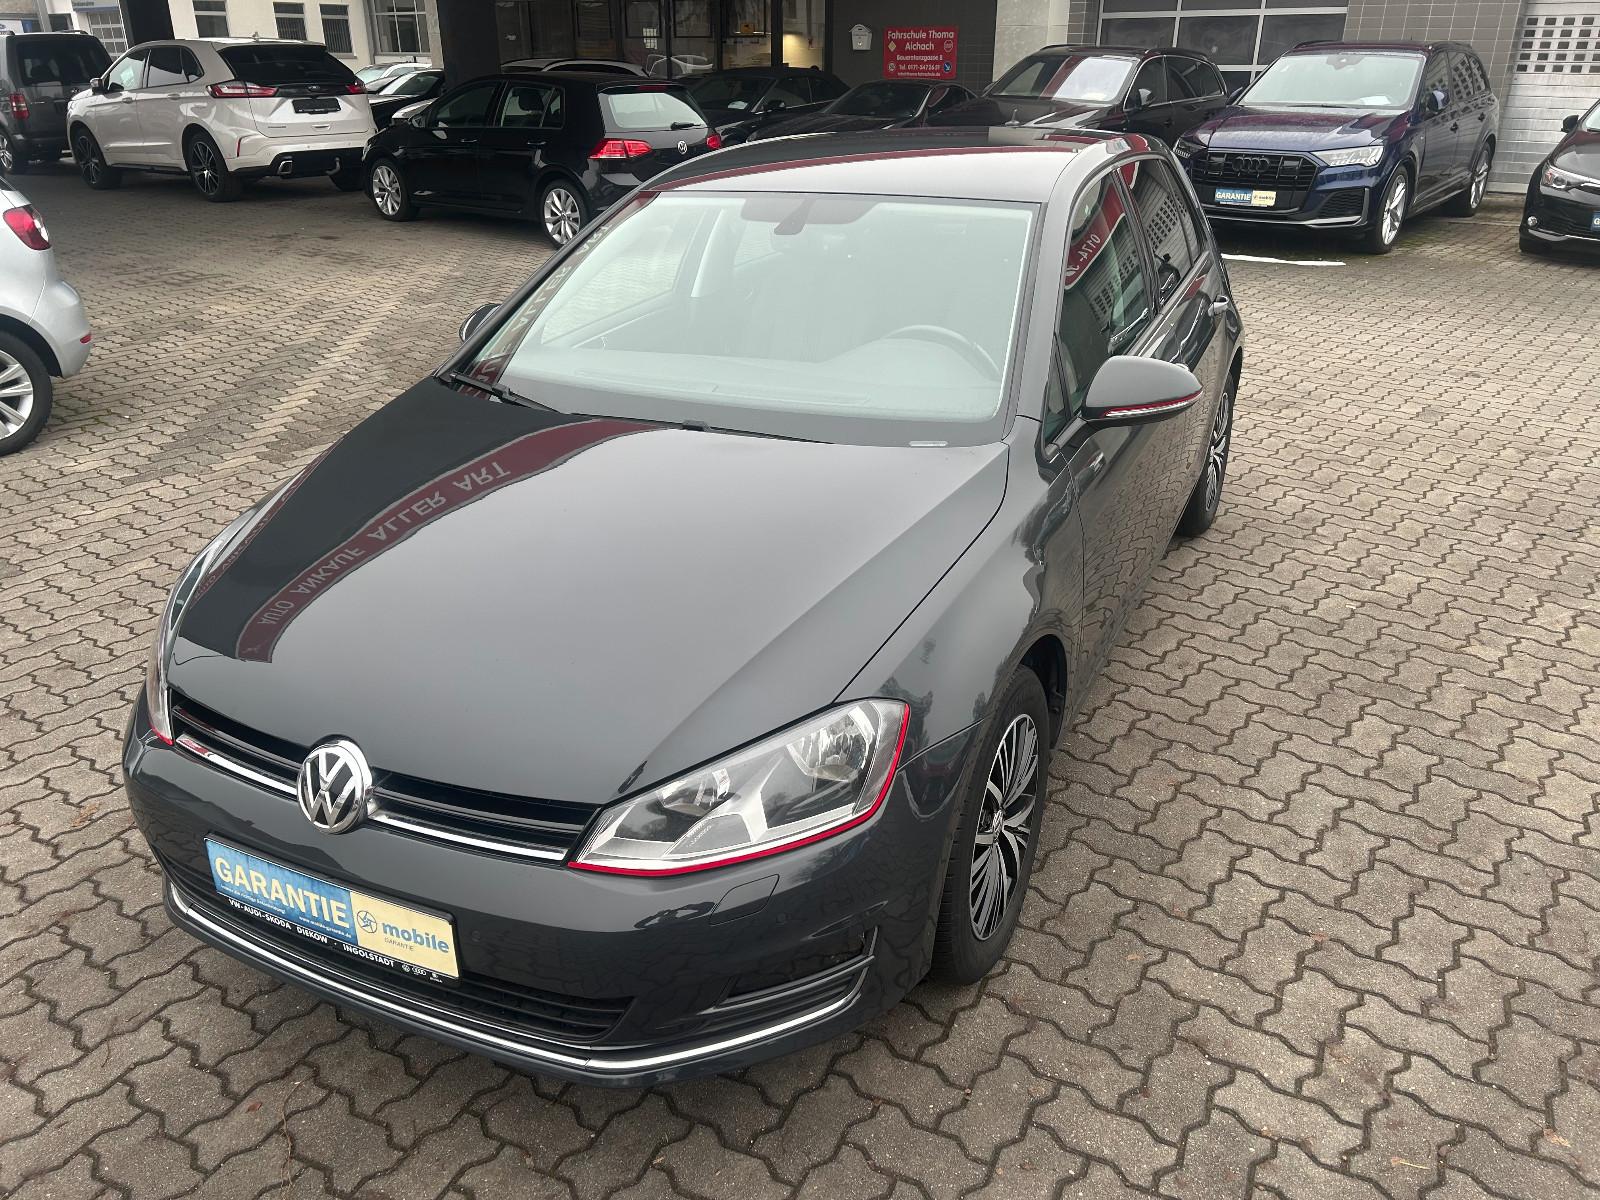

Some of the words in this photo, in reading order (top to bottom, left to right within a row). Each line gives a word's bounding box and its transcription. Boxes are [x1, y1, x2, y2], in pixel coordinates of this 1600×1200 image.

[887, 30, 926, 39] Fahrschule
[928, 30, 955, 39] Thoma
[905, 41, 935, 50] Aichach
[1216, 191, 1252, 201] GARANTIE
[214, 857, 350, 929] GARANTIE
[382, 921, 450, 954] mobile
[384, 937, 414, 952] GARANTIE
[296, 926, 328, 944] DIEKOW
[342, 943, 395, 968] INGOLSTADT
